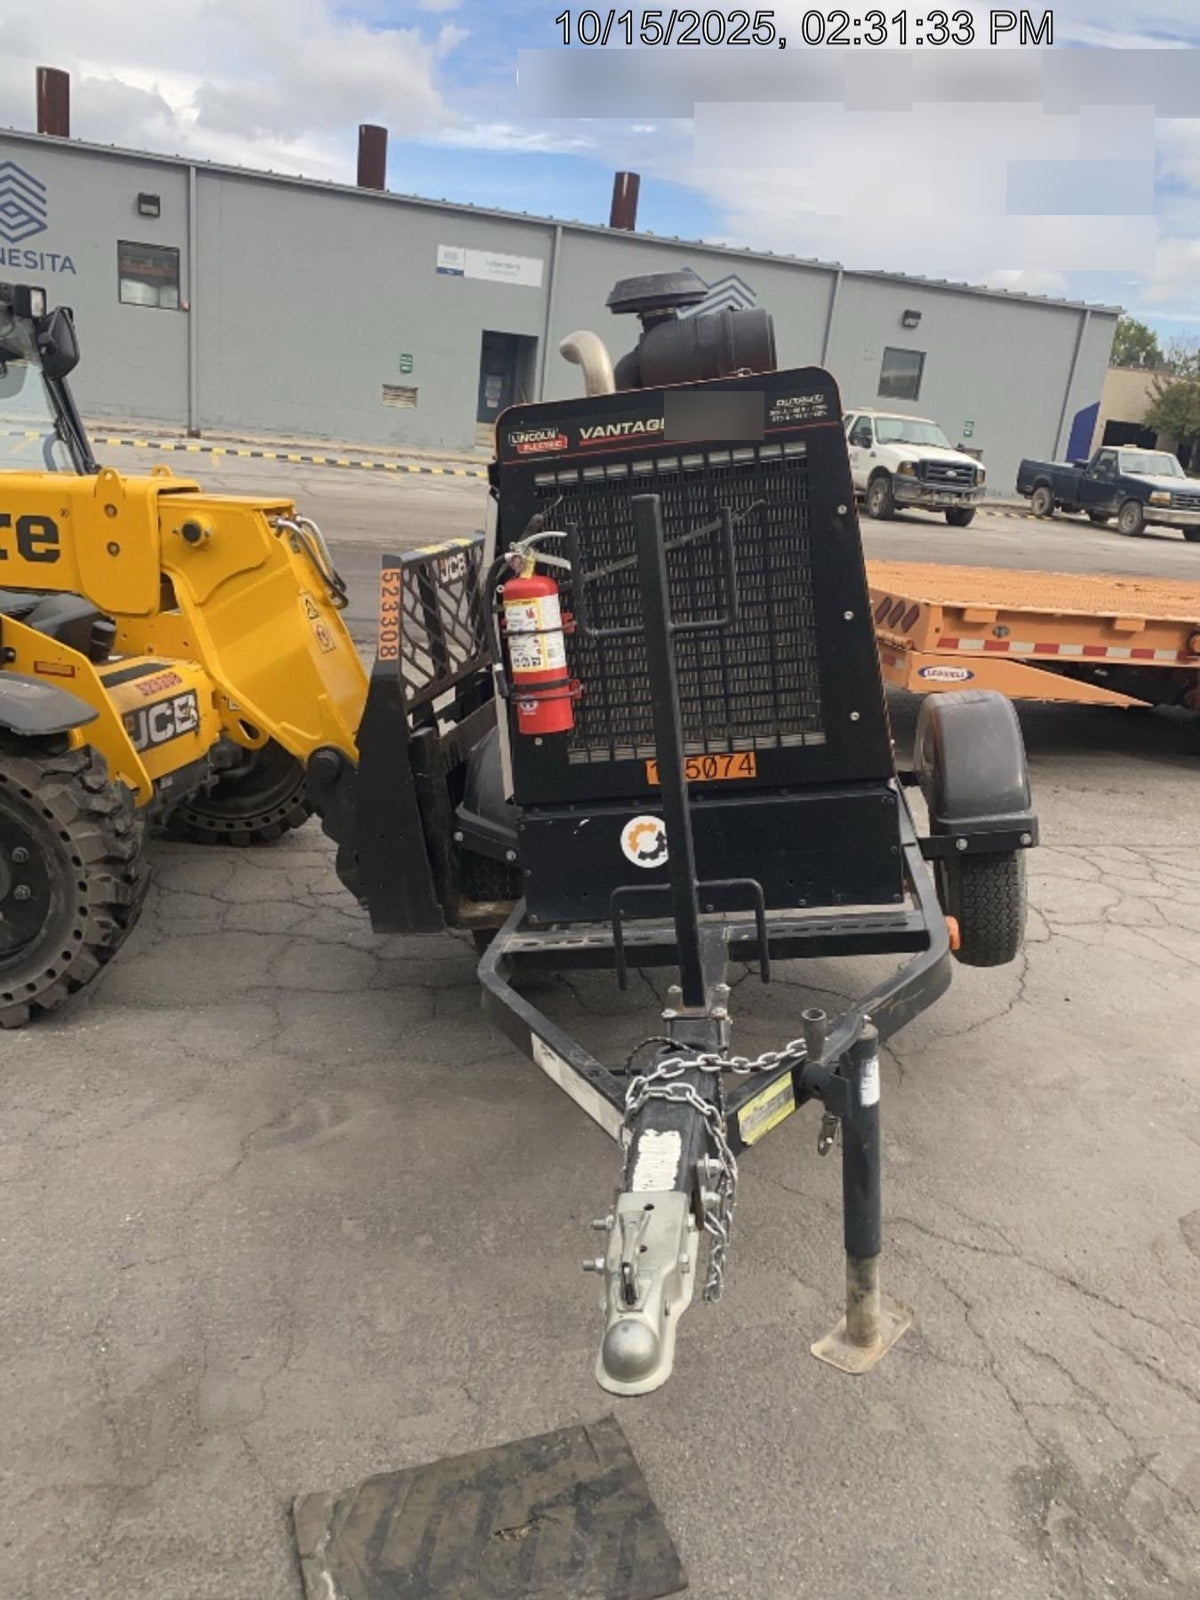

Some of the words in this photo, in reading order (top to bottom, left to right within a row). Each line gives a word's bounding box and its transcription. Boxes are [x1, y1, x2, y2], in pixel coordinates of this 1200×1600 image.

[511, 430, 556, 444] LINCOLN
[380, 571, 400, 658] 523308
[125, 694, 198, 750] JCB
